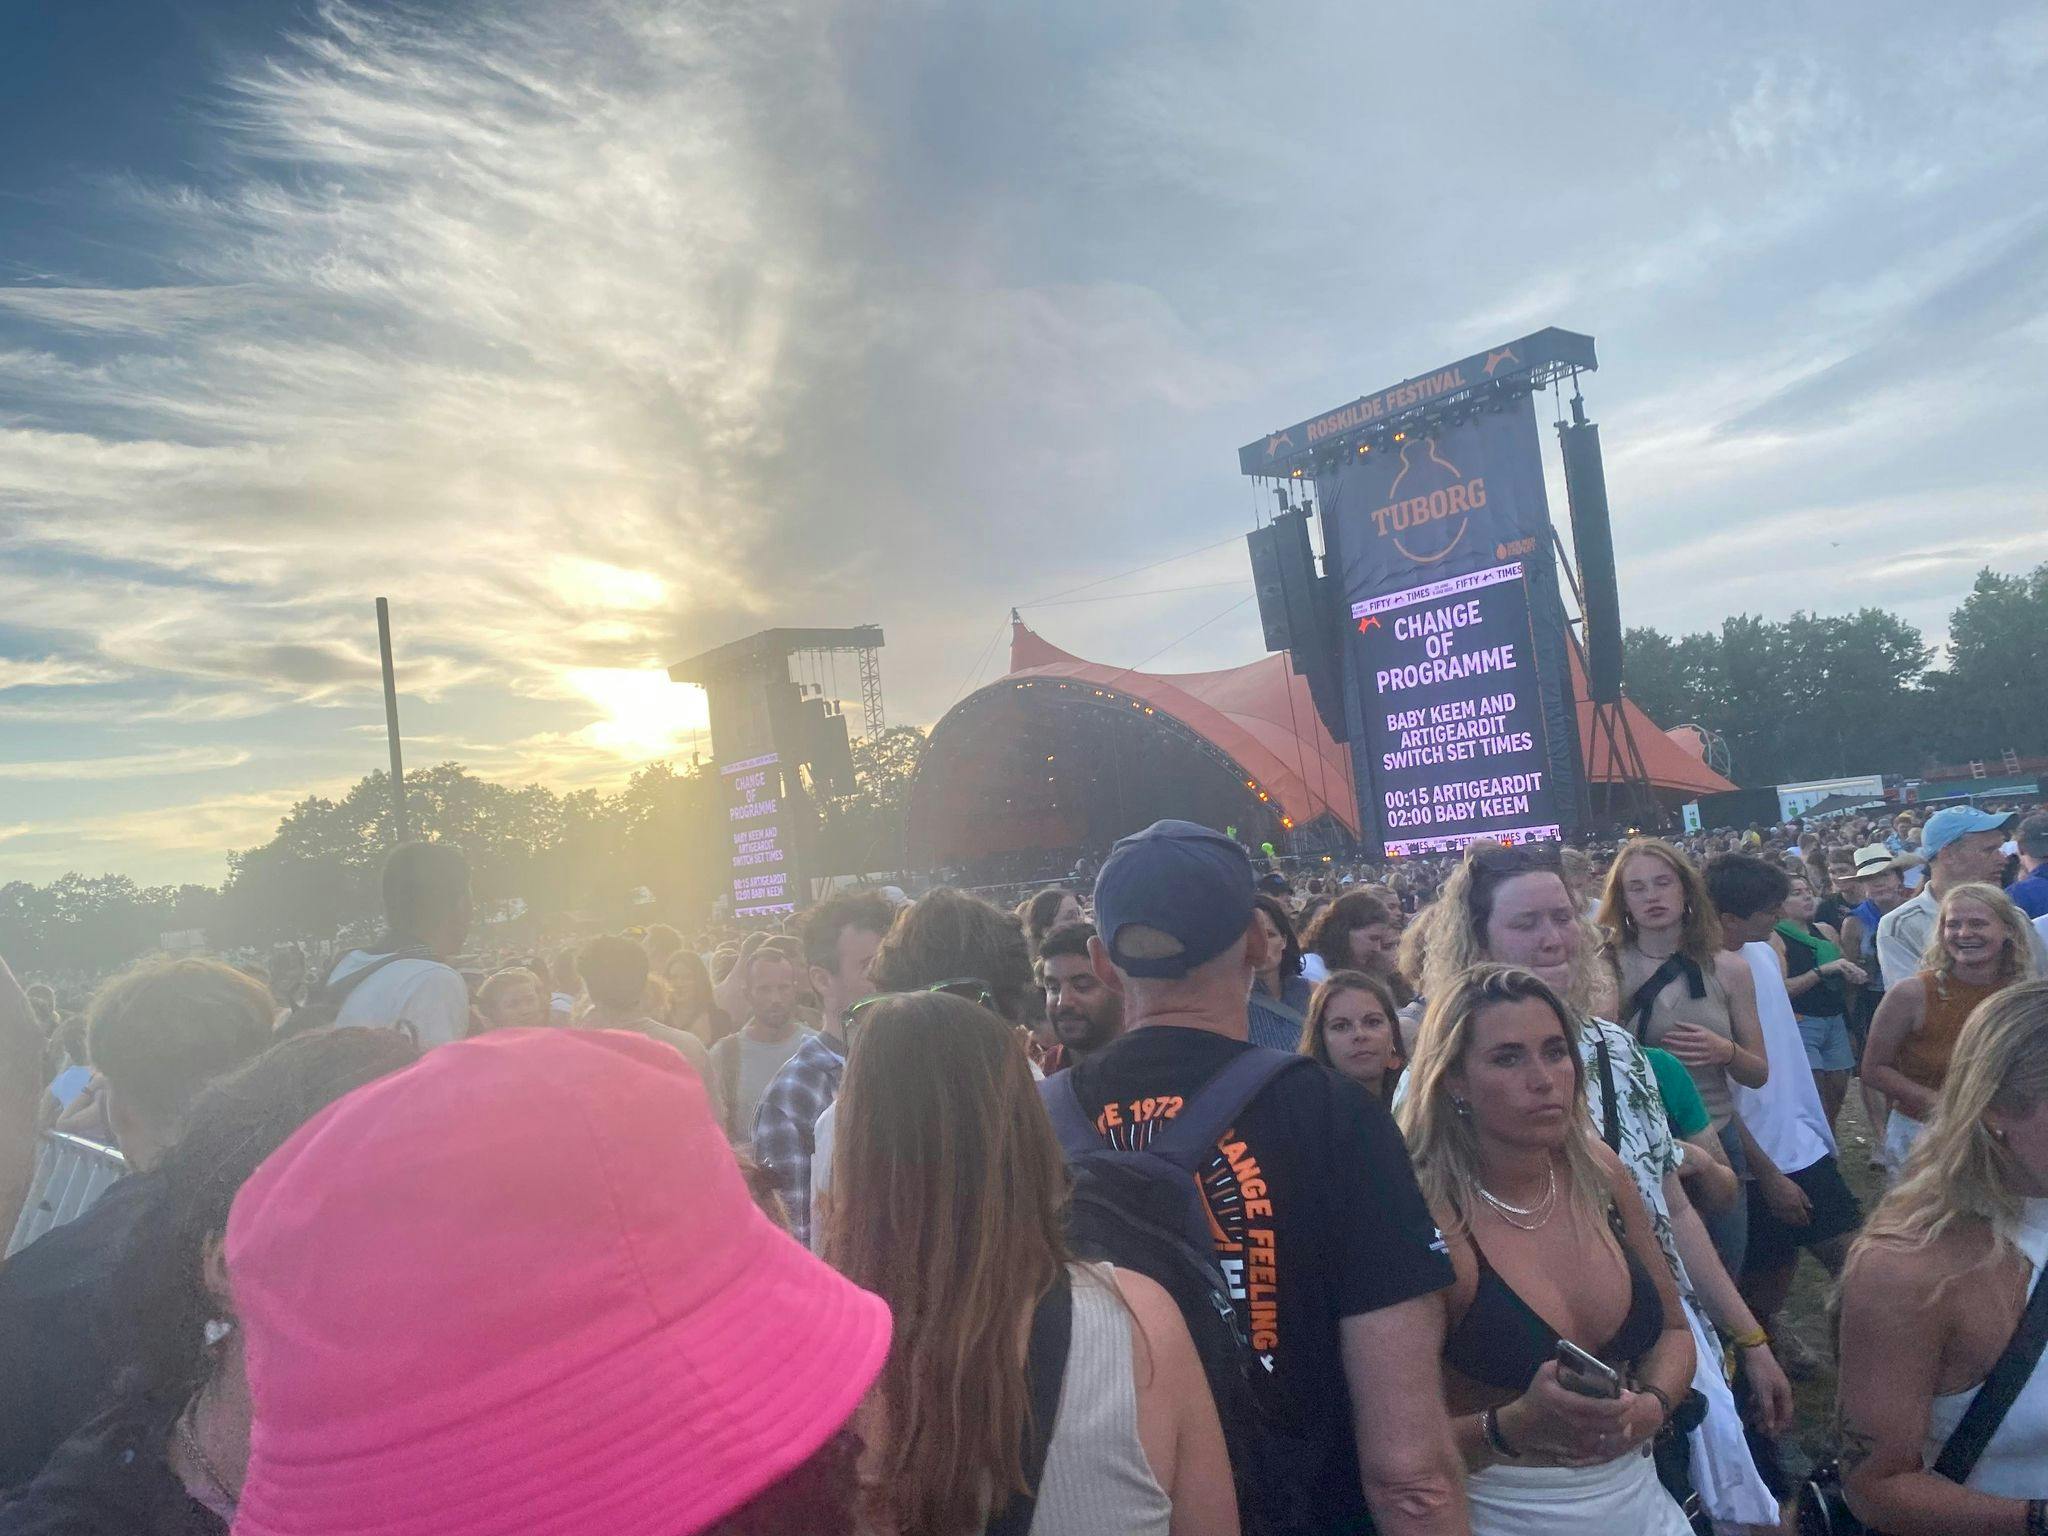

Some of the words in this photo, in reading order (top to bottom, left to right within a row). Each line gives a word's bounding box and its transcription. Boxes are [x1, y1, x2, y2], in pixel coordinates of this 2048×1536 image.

[1307, 396, 1384, 442] ROSKILDE
[1386, 367, 1466, 412] FESTIVAL
[1371, 478, 1486, 536] TUBORG
[1369, 598, 1391, 611] FIFTY
[1406, 588, 1430, 602] TIMES
[1455, 575, 1479, 589] FIFTY
[1498, 565, 1523, 579] TIMES
[1394, 600, 1482, 641] CHANGE
[1425, 631, 1454, 659] OF
[1376, 644, 1517, 693] PROGRAMME
[1386, 708, 1426, 731] BABY
[1430, 700, 1476, 724] KEEM
[1480, 692, 1516, 715] AND
[1383, 745, 1444, 771] SWITCH
[1447, 740, 1476, 761] SET
[1479, 732, 1533, 756] TIMES
[1401, 715, 1506, 749] ARTIGEARDIT
[736, 772, 765, 791] CHANGE
[1385, 787, 1429, 809] 00:15
[1432, 772, 1542, 803] ARTIGEARDIT
[1387, 807, 1432, 828] 02:00
[1435, 801, 1476, 823] BABY
[1480, 795, 1529, 817] KEEM
[1130, 1096, 1184, 1122] 1972
[1248, 1229, 1278, 1350] FEELING
